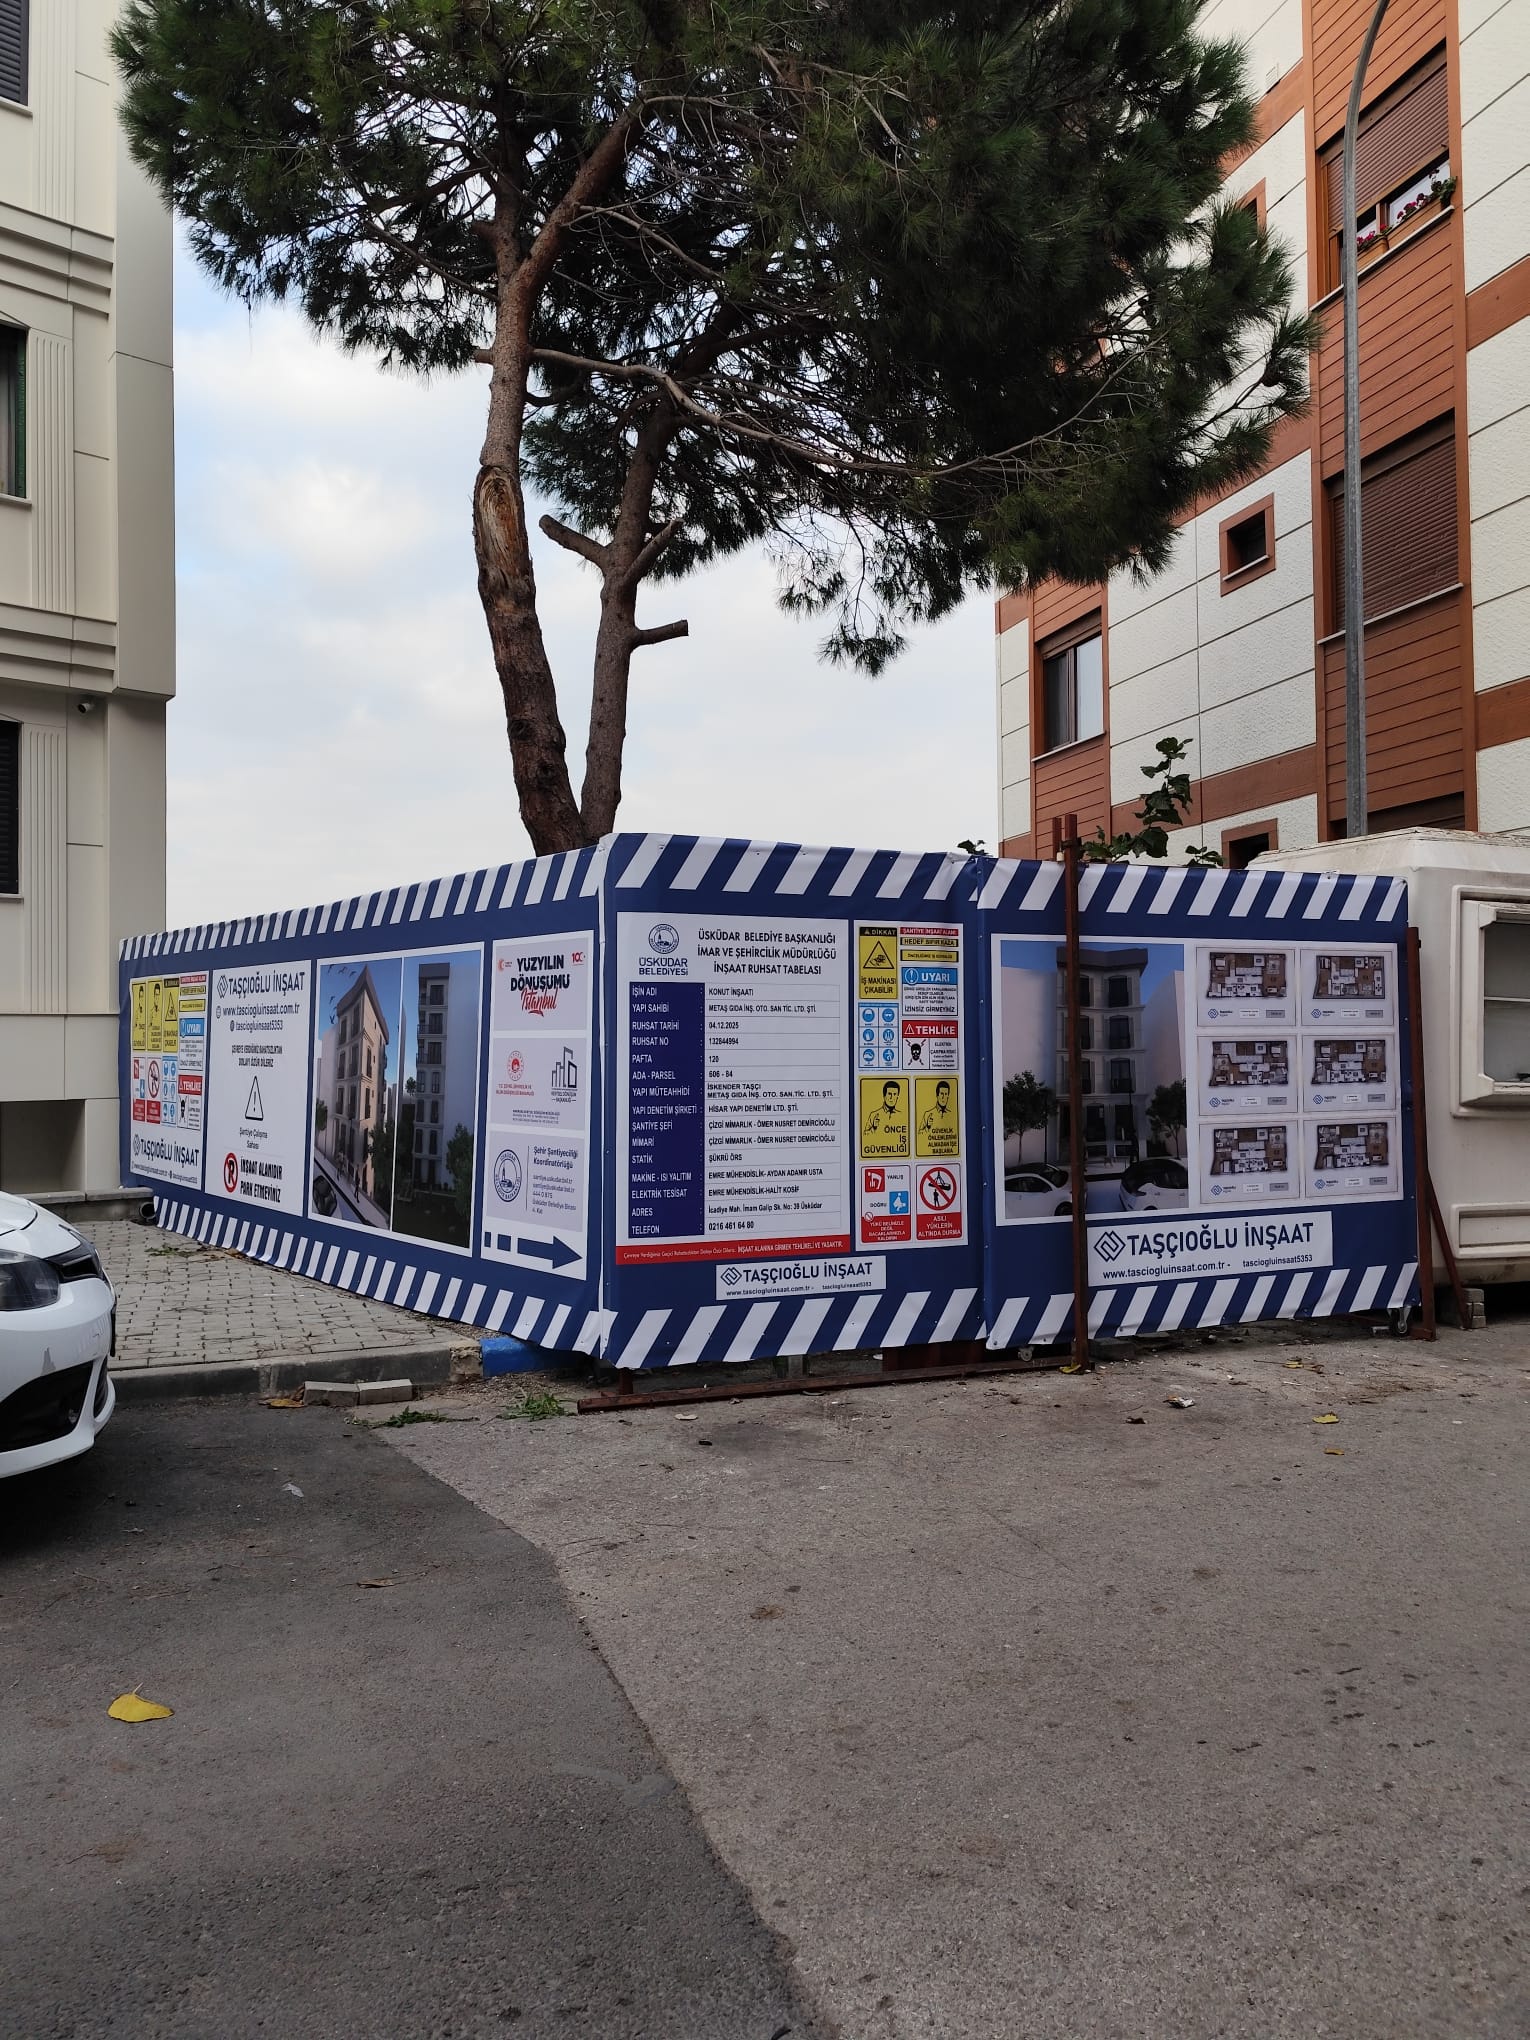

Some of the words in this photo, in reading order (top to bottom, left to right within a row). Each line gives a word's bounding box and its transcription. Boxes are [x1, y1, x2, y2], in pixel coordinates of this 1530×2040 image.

[699, 928, 740, 942] ÜSKÜDAR
[745, 930, 782, 942] BELEDİYE
[785, 931, 835, 945] BAŞKANLIĞI
[698, 944, 719, 956] İMAR
[722, 947, 733, 957] VE
[736, 946, 780, 958] ŞEHİRCİLİK
[783, 947, 836, 960] MÜDÜRLÜĞÜ
[639, 957, 687, 967] ÜSKÜDAR
[714, 962, 746, 975] İNŞAAT
[749, 964, 782, 974] RUHSAT
[782, 965, 821, 975] TABELASI
[922, 972, 949, 982] UYARI
[229, 972, 270, 999] TAŞÇIOĞLU
[273, 970, 305, 996] İNŞAAT
[864, 985, 893, 994] ÇIKABİLİR
[632, 985, 644, 997] İŞİN
[646, 987, 657, 996] ADI
[731, 987, 753, 997] İNŞAATI
[223, 1003, 300, 1018] www.tasciogluinsaat.com.tr
[632, 1004, 646, 1012] YAPI
[648, 1002, 669, 1012] SAHİBİ
[709, 1005, 727, 1013] METAŞ
[632, 1022, 658, 1030] RUHSAT
[660, 1020, 679, 1030] TARİHİ
[916, 1025, 955, 1034] TEHLİKE
[632, 1037, 658, 1045] RUHSAT
[660, 1037, 668, 1045] NO
[632, 1055, 652, 1063] PAFTA
[652, 1071, 675, 1079] PARSEL
[632, 1088, 647, 1096] YAPI
[649, 1086, 690, 1096] MÜTEAHHİDİ
[632, 1106, 645, 1114] YAPI
[647, 1105, 673, 1114] DENETİM
[675, 1104, 697, 1115] ŞİRKETİ
[709, 1104, 728, 1112] HİSAR
[745, 1104, 772, 1112] DENETİM
[632, 1120, 658, 1132] ŞANTİYE
[660, 1120, 672, 1131] ŞEFİ
[709, 1120, 723, 1130] ÇİZGİ
[725, 1120, 752, 1128] MİMARLIK
[798, 1118, 835, 1127] DEMİRCİOĞLU
[884, 1124, 906, 1133] ÖNCE
[632, 1136, 654, 1146] MİMARİ
[709, 1136, 723, 1146] ÇİZGİ
[725, 1136, 752, 1144] MİMARLIK
[798, 1134, 835, 1142] DEMİRCİOĞLU
[899, 1135, 906, 1144] İŞ
[141, 1138, 172, 1161] TAŞÇIOĞLU
[174, 1140, 199, 1168] İNŞAAT
[534, 1146, 546, 1155] Şehir
[864, 1144, 906, 1153] GÜVENLİĞİ
[632, 1153, 653, 1163] STATİK
[709, 1153, 728, 1163] ŞÜKRÜ
[730, 1153, 742, 1161] ÖRS
[240, 1156, 257, 1176] İNŞAAT
[259, 1161, 282, 1180] ALANIDIR
[632, 1172, 655, 1182] MAKİNE
[670, 1172, 691, 1181] YALITIM
[240, 1181, 253, 1196] PARK
[254, 1184, 281, 1203] ETMEYİNİZ
[632, 1188, 661, 1198] ELEKTRİK
[663, 1187, 687, 1197] TESİSAT
[632, 1208, 653, 1216] ADRES
[632, 1225, 659, 1234] TELEFON
[709, 1222, 723, 1230] 0216
[1127, 1224, 1237, 1259] TAŞÇIOĞLU
[1245, 1222, 1313, 1251] İNŞAAT
[1243, 1255, 1312, 1268] tasciogluinsaat5353
[743, 1264, 819, 1285] TAŞÇIOĞLU
[824, 1262, 872, 1279] İNŞAAT
[1103, 1261, 1225, 1280] www.tasciogluinsaat.com.tr
[726, 1285, 810, 1296] www.tasciogluinsaat.com.tr
